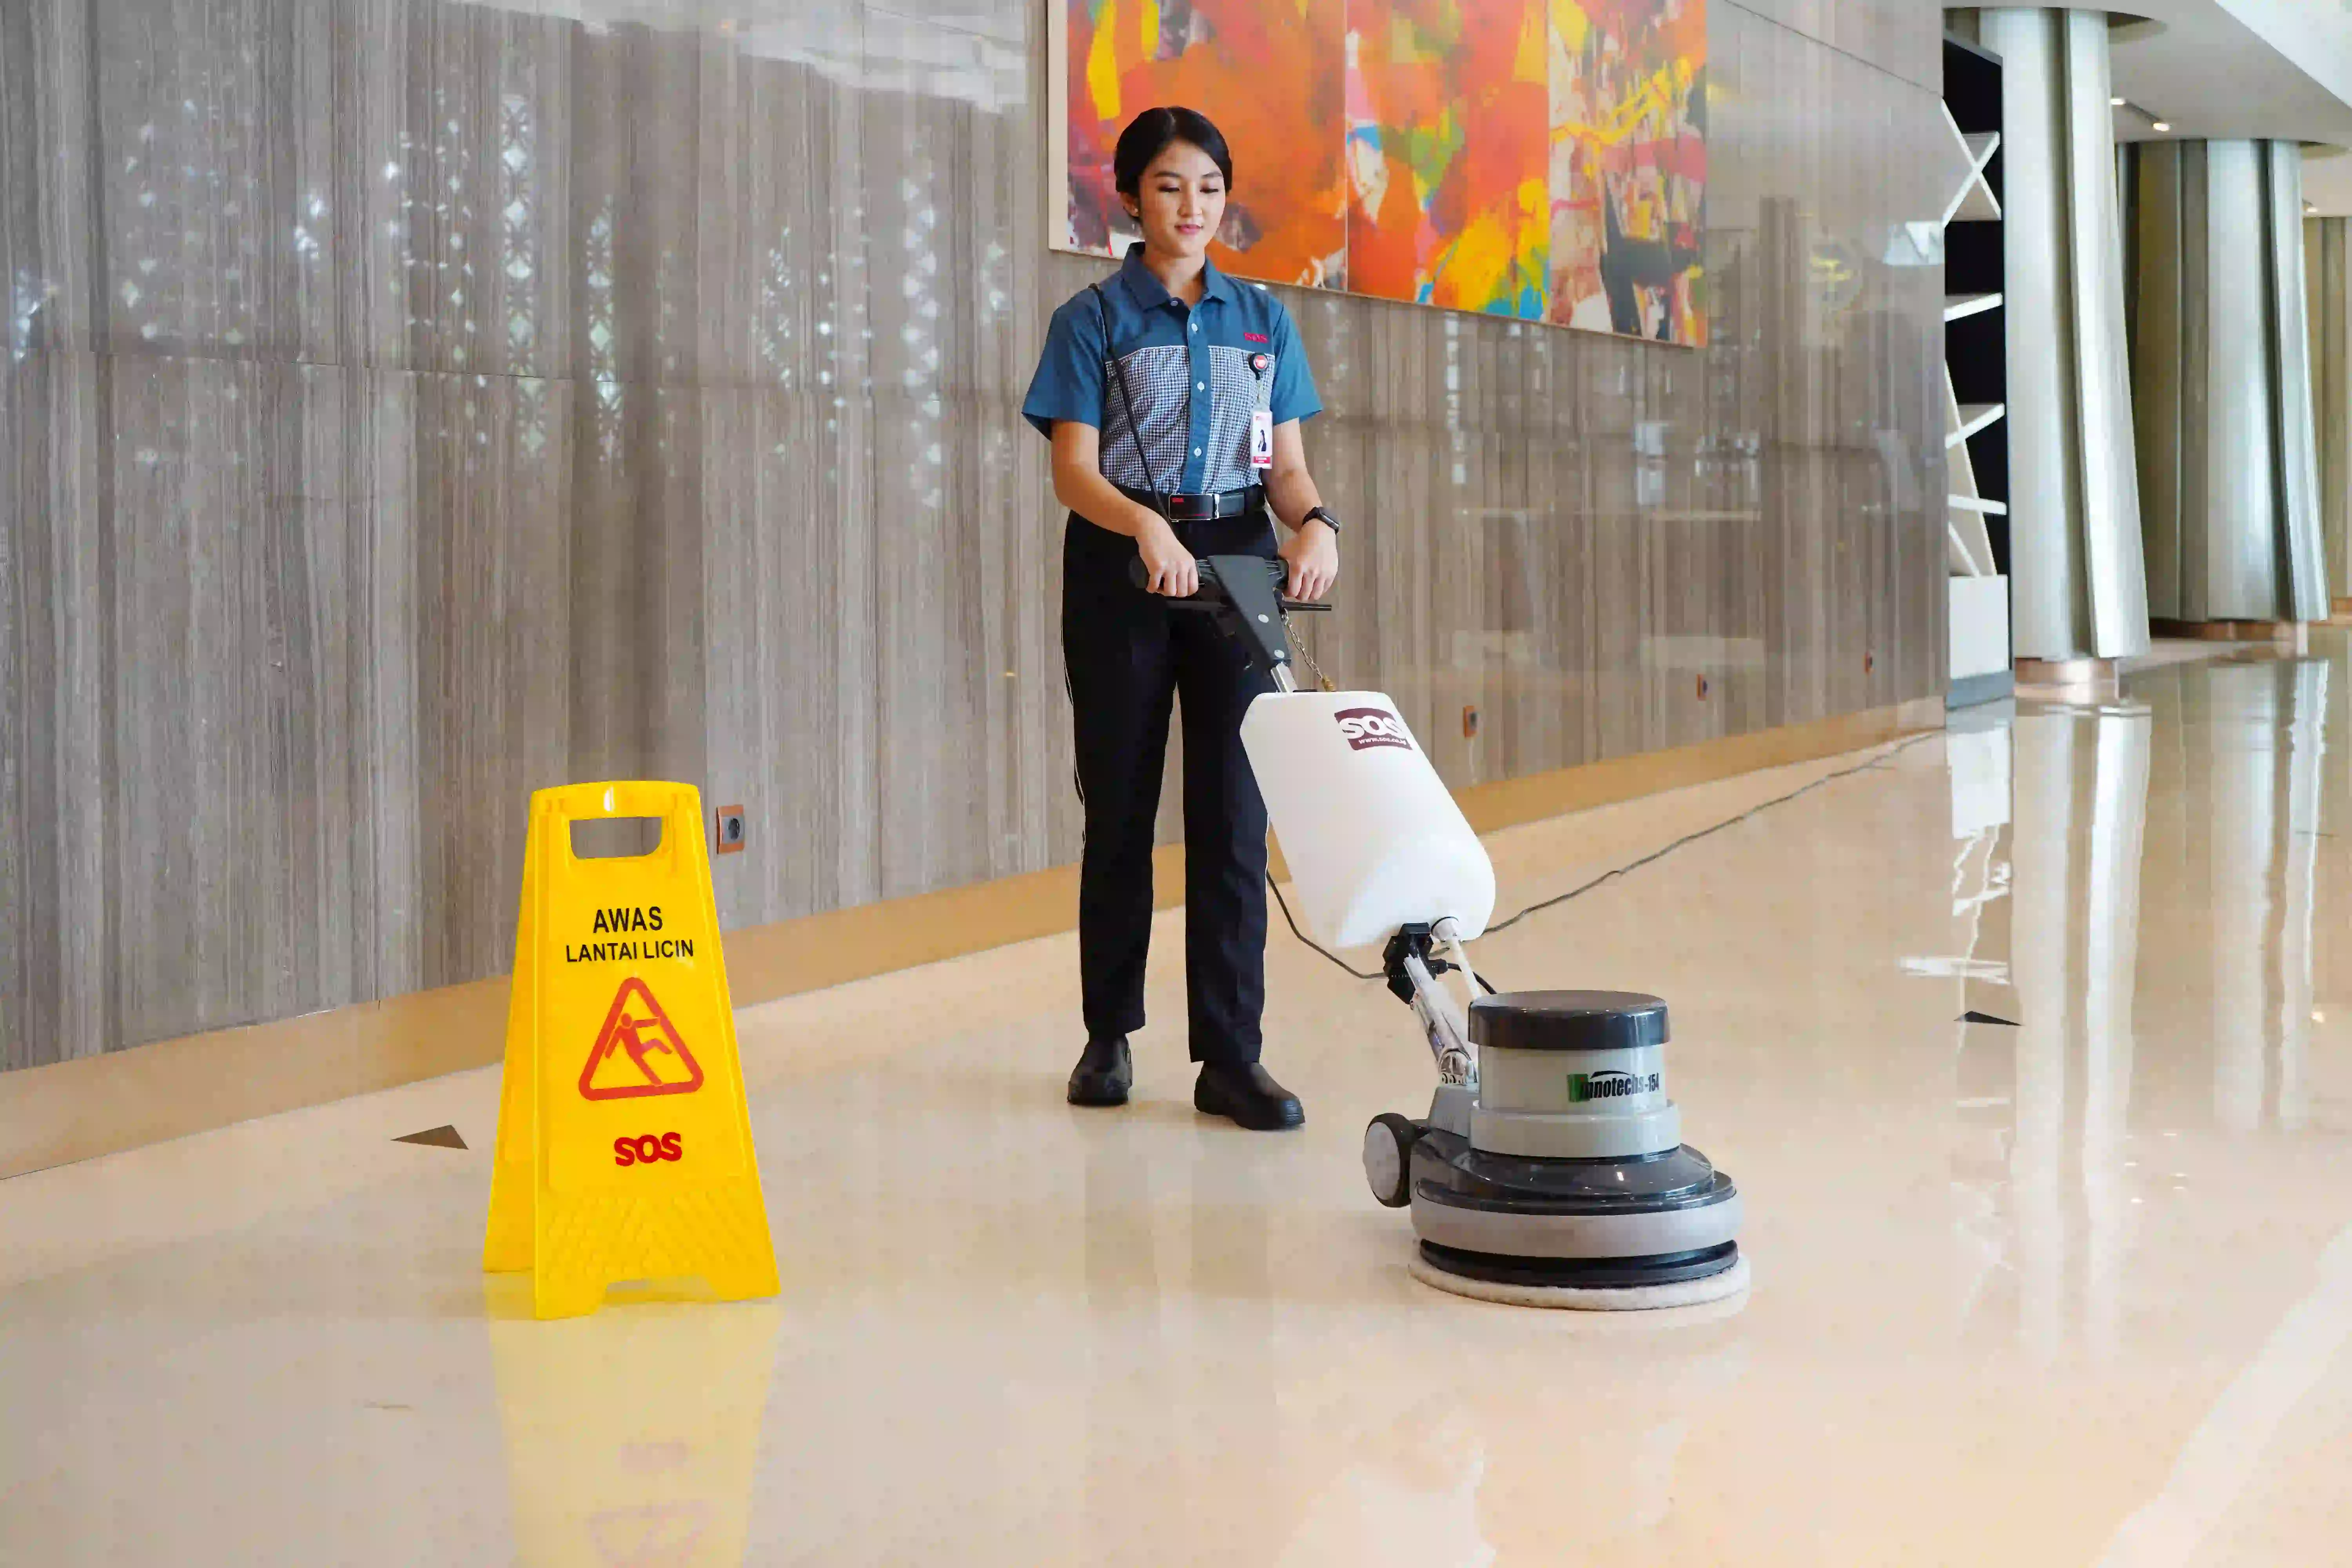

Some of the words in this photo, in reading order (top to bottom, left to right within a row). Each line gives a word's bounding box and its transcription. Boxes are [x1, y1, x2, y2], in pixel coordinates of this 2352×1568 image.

[1339, 715, 1406, 739] SOS
[593, 906, 663, 933] AWAS
[566, 942, 637, 962] LANTAI
[643, 939, 693, 959] LICIN
[613, 1132, 682, 1167] SOS
